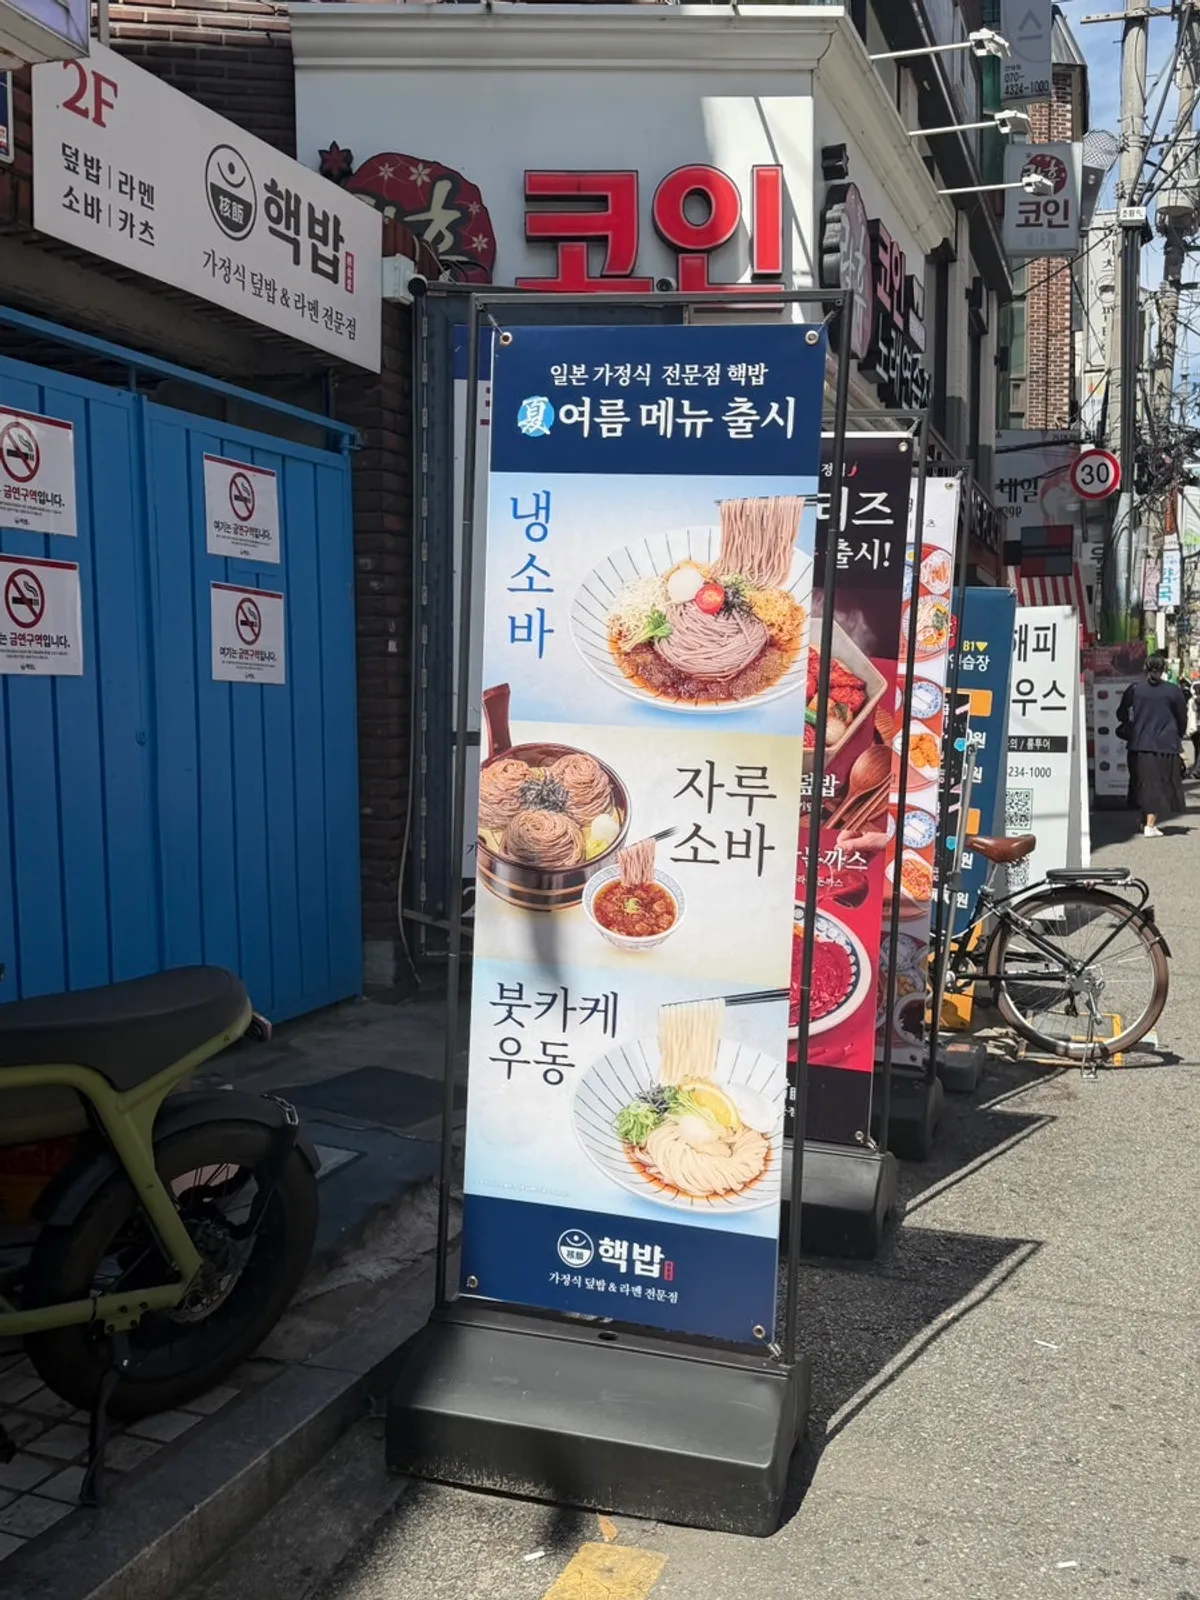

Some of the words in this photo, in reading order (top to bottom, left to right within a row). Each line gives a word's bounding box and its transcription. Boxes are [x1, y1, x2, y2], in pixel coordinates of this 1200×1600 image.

[63, 58, 118, 128] 2F
[61, 142, 102, 186] 덮밥
[118, 171, 154, 211] 라멘
[62, 185, 102, 224] 소바
[118, 209, 154, 246] 카츠
[264, 178, 344, 284] 핵밥
[515, 163, 785, 312] 코인
[1015, 199, 1069, 229] 코인
[203, 249, 246, 291] 가정식
[250, 271, 277, 305] 덮밥
[282, 288, 290, 308] &
[294, 293, 319, 324] 라멘
[322, 306, 356, 341] 전문점
[875, 220, 905, 331] 코인
[550, 363, 589, 386] 일본
[593, 363, 651, 387] 가정식
[662, 363, 721, 387] 전문점
[727, 363, 769, 387] 핵밥
[559, 396, 631, 438] 여름
[639, 396, 713, 439] 메뉴
[721, 396, 796, 440] 출시
[1081, 463, 1110, 485] 30
[673, 759, 777, 817] 자루
[669, 822, 775, 877] 소바
[489, 982, 619, 1039] 붓카케
[488, 1036, 576, 1086] 우동
[598, 1236, 665, 1278] 핵밥
[549, 1271, 582, 1289] 가정식
[585, 1277, 606, 1292] 덮밥
[608, 1282, 617, 1293] &
[620, 1283, 642, 1298] 라멘
[644, 1287, 679, 1304] 전문점
